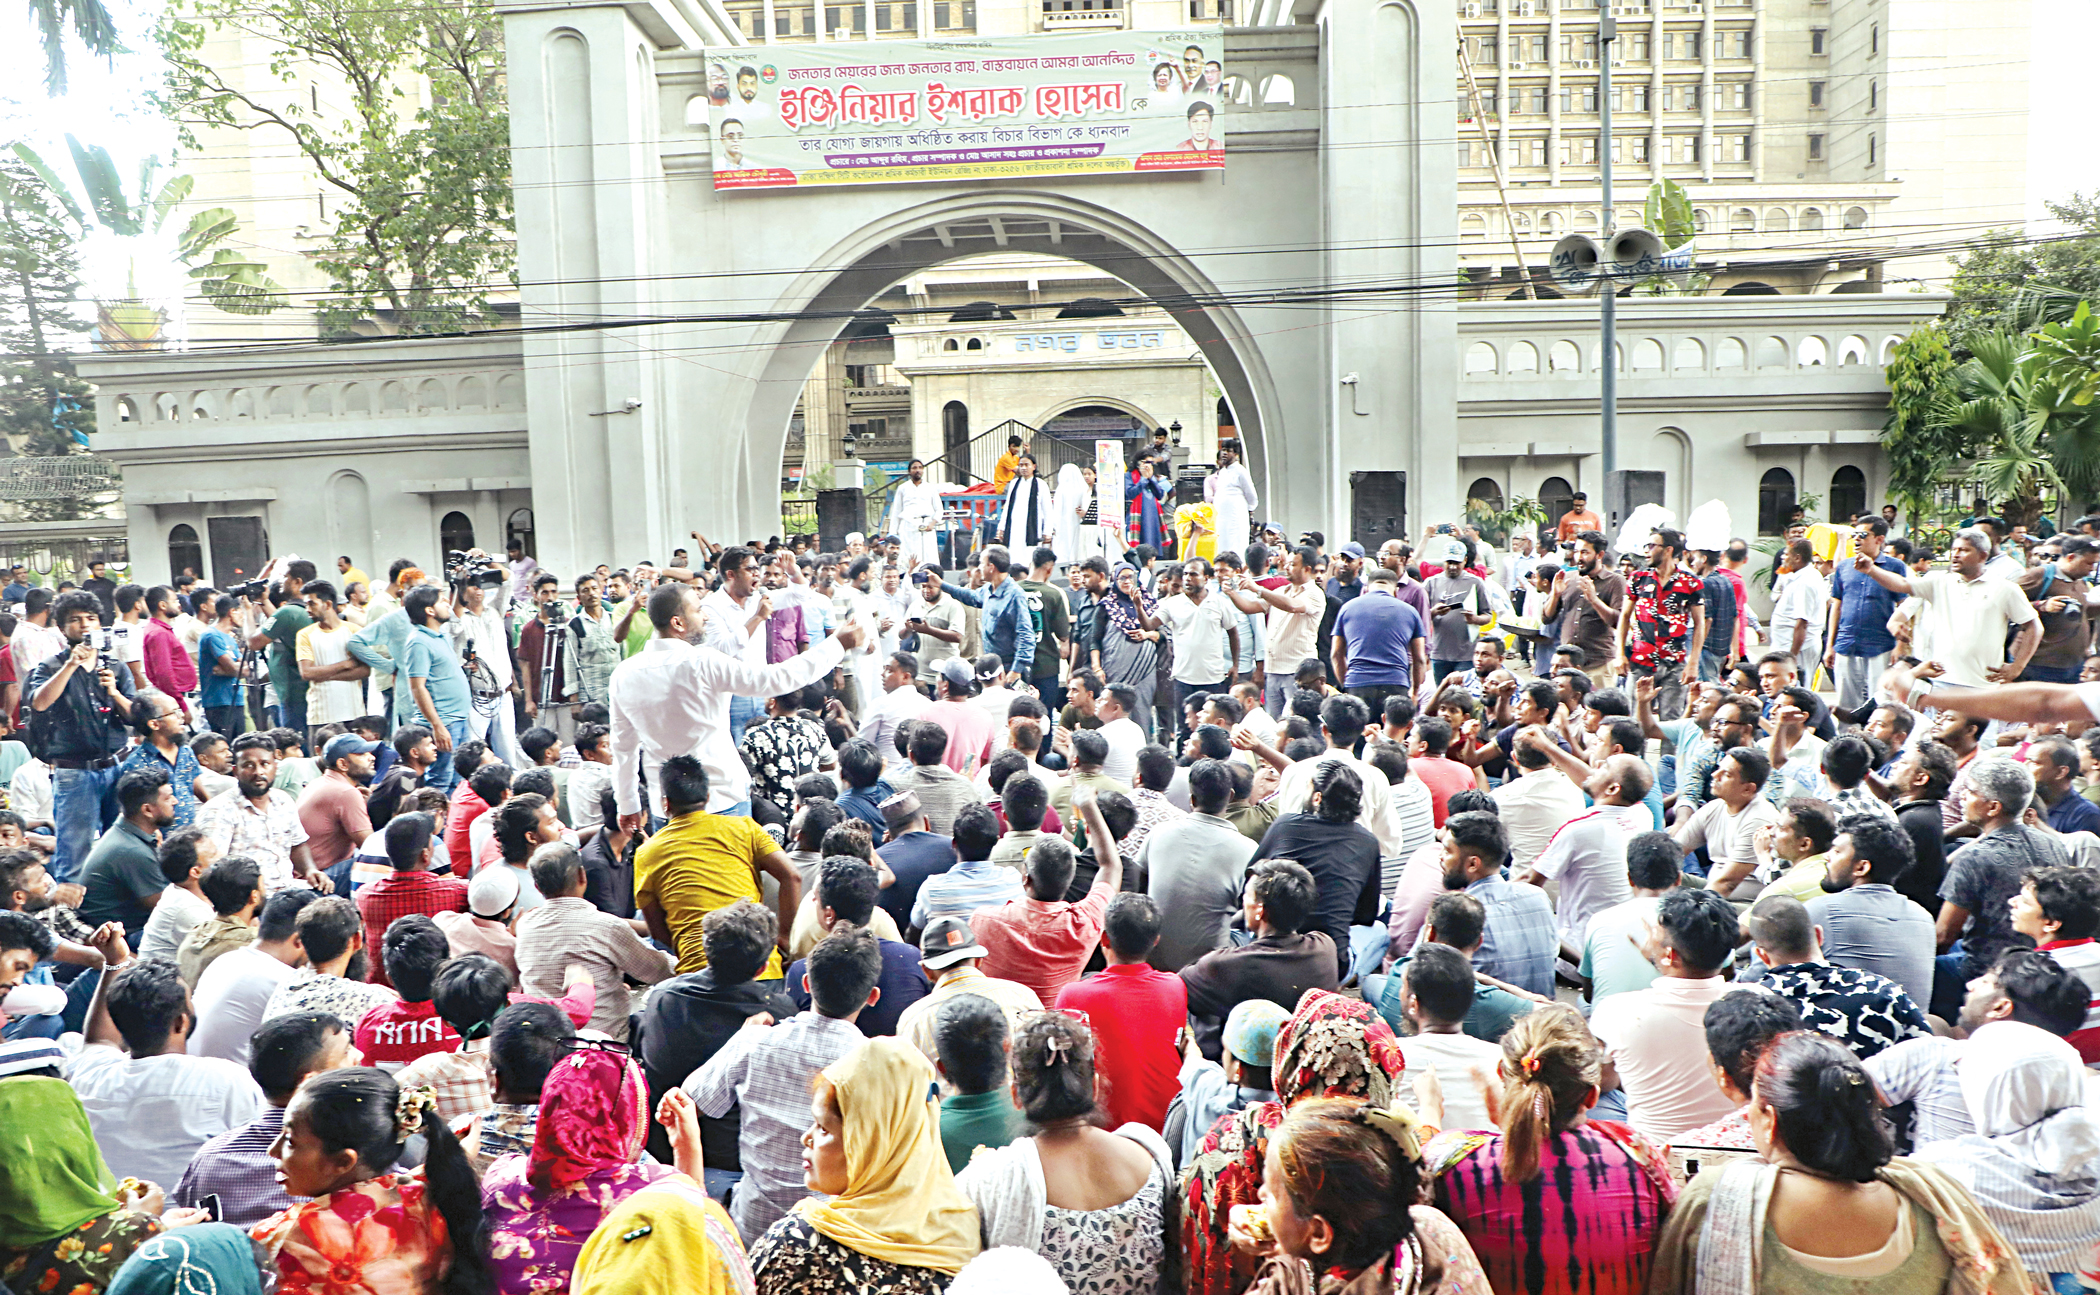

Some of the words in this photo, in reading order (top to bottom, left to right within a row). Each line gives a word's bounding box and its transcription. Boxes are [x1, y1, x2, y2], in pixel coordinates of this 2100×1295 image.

[788, 68, 831, 80] জনতার
[834, 66, 877, 79] মেয়রের
[880, 64, 905, 76] জন্য
[908, 62, 951, 74] জনতার
[955, 61, 979, 74] রায়,
[982, 58, 1038, 72] বাস্তবায়নে
[1041, 56, 1079, 69] আমরা
[1082, 51, 1135, 67] আনন্দিত
[779, 84, 917, 129] ইঞ্জিনিয়ার
[926, 82, 1024, 121] ইশরাক
[1036, 84, 1123, 117] হোসেন
[1131, 97, 1148, 111] কে
[798, 139, 822, 151] তার
[826, 137, 856, 151] যোগ্য
[859, 135, 903, 149] জায়গায়
[907, 128, 953, 147] অধিষ্ঠিত
[957, 131, 988, 144] করায়
[992, 127, 1024, 143] বিচার
[1028, 125, 1062, 141] বিভাগ
[1067, 127, 1083, 139] কে
[1015, 332, 1082, 353] নগর
[1097, 330, 1165, 349] ভবন
